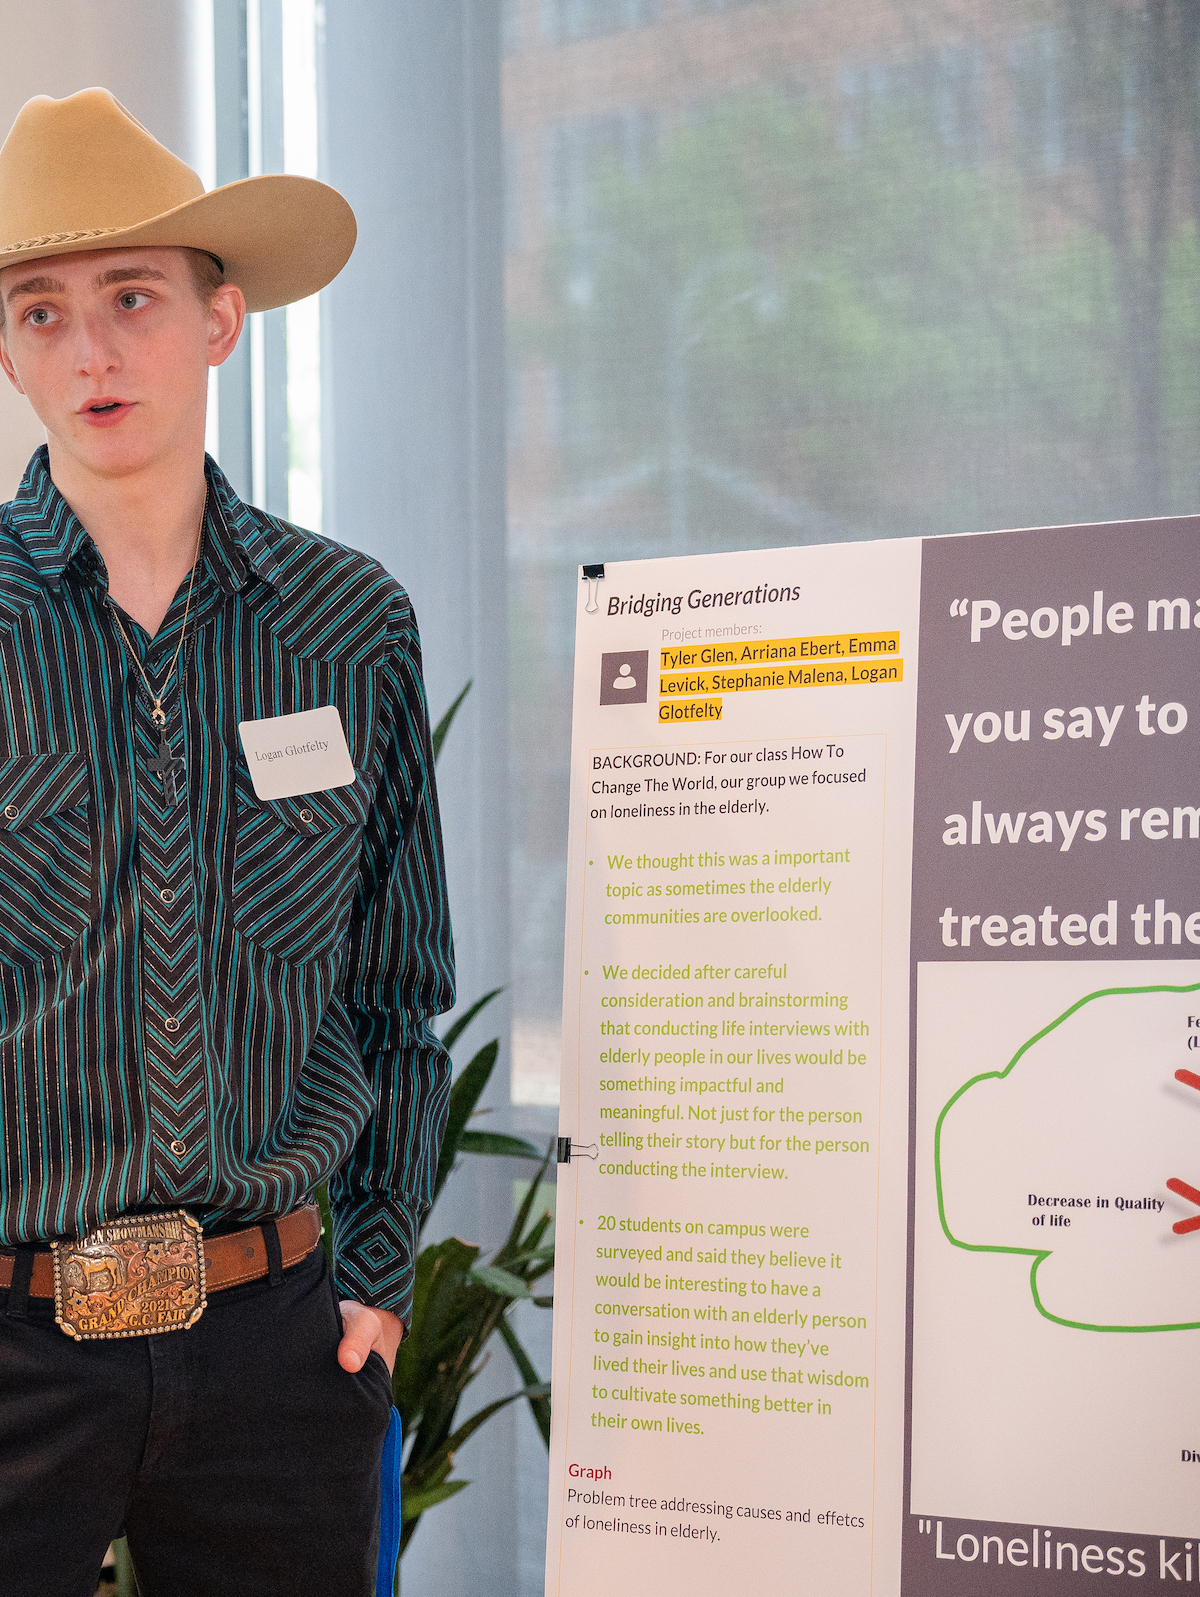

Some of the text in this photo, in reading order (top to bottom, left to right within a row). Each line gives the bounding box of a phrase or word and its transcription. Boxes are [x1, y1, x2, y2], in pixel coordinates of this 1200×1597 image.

[608, 584, 800, 617] Bridging Generations
[662, 623, 762, 642] Project members:
[661, 638, 896, 669] Tyler Glen, Arriana Ebert, Emma
[660, 666, 897, 693] Levick, Stephanie Malena, Logan
[659, 703, 722, 720] Glotfelty
[945, 695, 1187, 753] you say to
[255, 740, 329, 762] Logan Glotfelty
[593, 744, 844, 769] BACKGROUND: For our class How To
[592, 768, 866, 795] Change The World, our group we focused
[591, 799, 769, 818] on loneliness in the elderly.
[942, 801, 1107, 851] always
[607, 849, 850, 871] We thought this was important
[606, 877, 831, 899] topic sometimes the elderly
[605, 906, 821, 924] communities are overlooked.
[939, 900, 1117, 946] treated
[603, 963, 786, 979] We decided after careful
[601, 992, 848, 1010] consideration and brainstorming
[601, 1020, 869, 1039] that conducting life interviews with
[600, 1048, 866, 1066] elderly people in our lives would be
[600, 1076, 783, 1095] something impactful and
[600, 1104, 862, 1125] meaningful. Not just for the person
[600, 1132, 869, 1154] telling their story but for the person
[599, 1160, 787, 1179] conducting the interview.
[1029, 1194, 1164, 1212] Decrease Quality
[598, 1215, 809, 1238] 20 students on campus were
[1032, 1215, 1070, 1226] of life
[597, 1246, 826, 1268] surveyed and said they believe
[596, 1273, 808, 1297] would interesting have
[79, 1266, 197, 1331] GRAND CHAMPION
[142, 1299, 170, 1312] 2021
[129, 1309, 186, 1326] G.C. FAIR
[595, 1303, 866, 1329] conversation with an elderly person
[613, 1329, 643, 1346] gain
[647, 1330, 696, 1350] insight
[701, 1334, 730, 1350] into
[735, 1335, 767, 1352] how
[594, 1355, 869, 1387] lived their lives and use that wisdom
[612, 1386, 831, 1414] cultivate something better in
[591, 1412, 703, 1434] their own lives.
[569, 1464, 611, 1481] Graph
[568, 1489, 864, 1527] Problem tree addressing causes and effetcs
[566, 1515, 720, 1543] of loneliness elderly.
